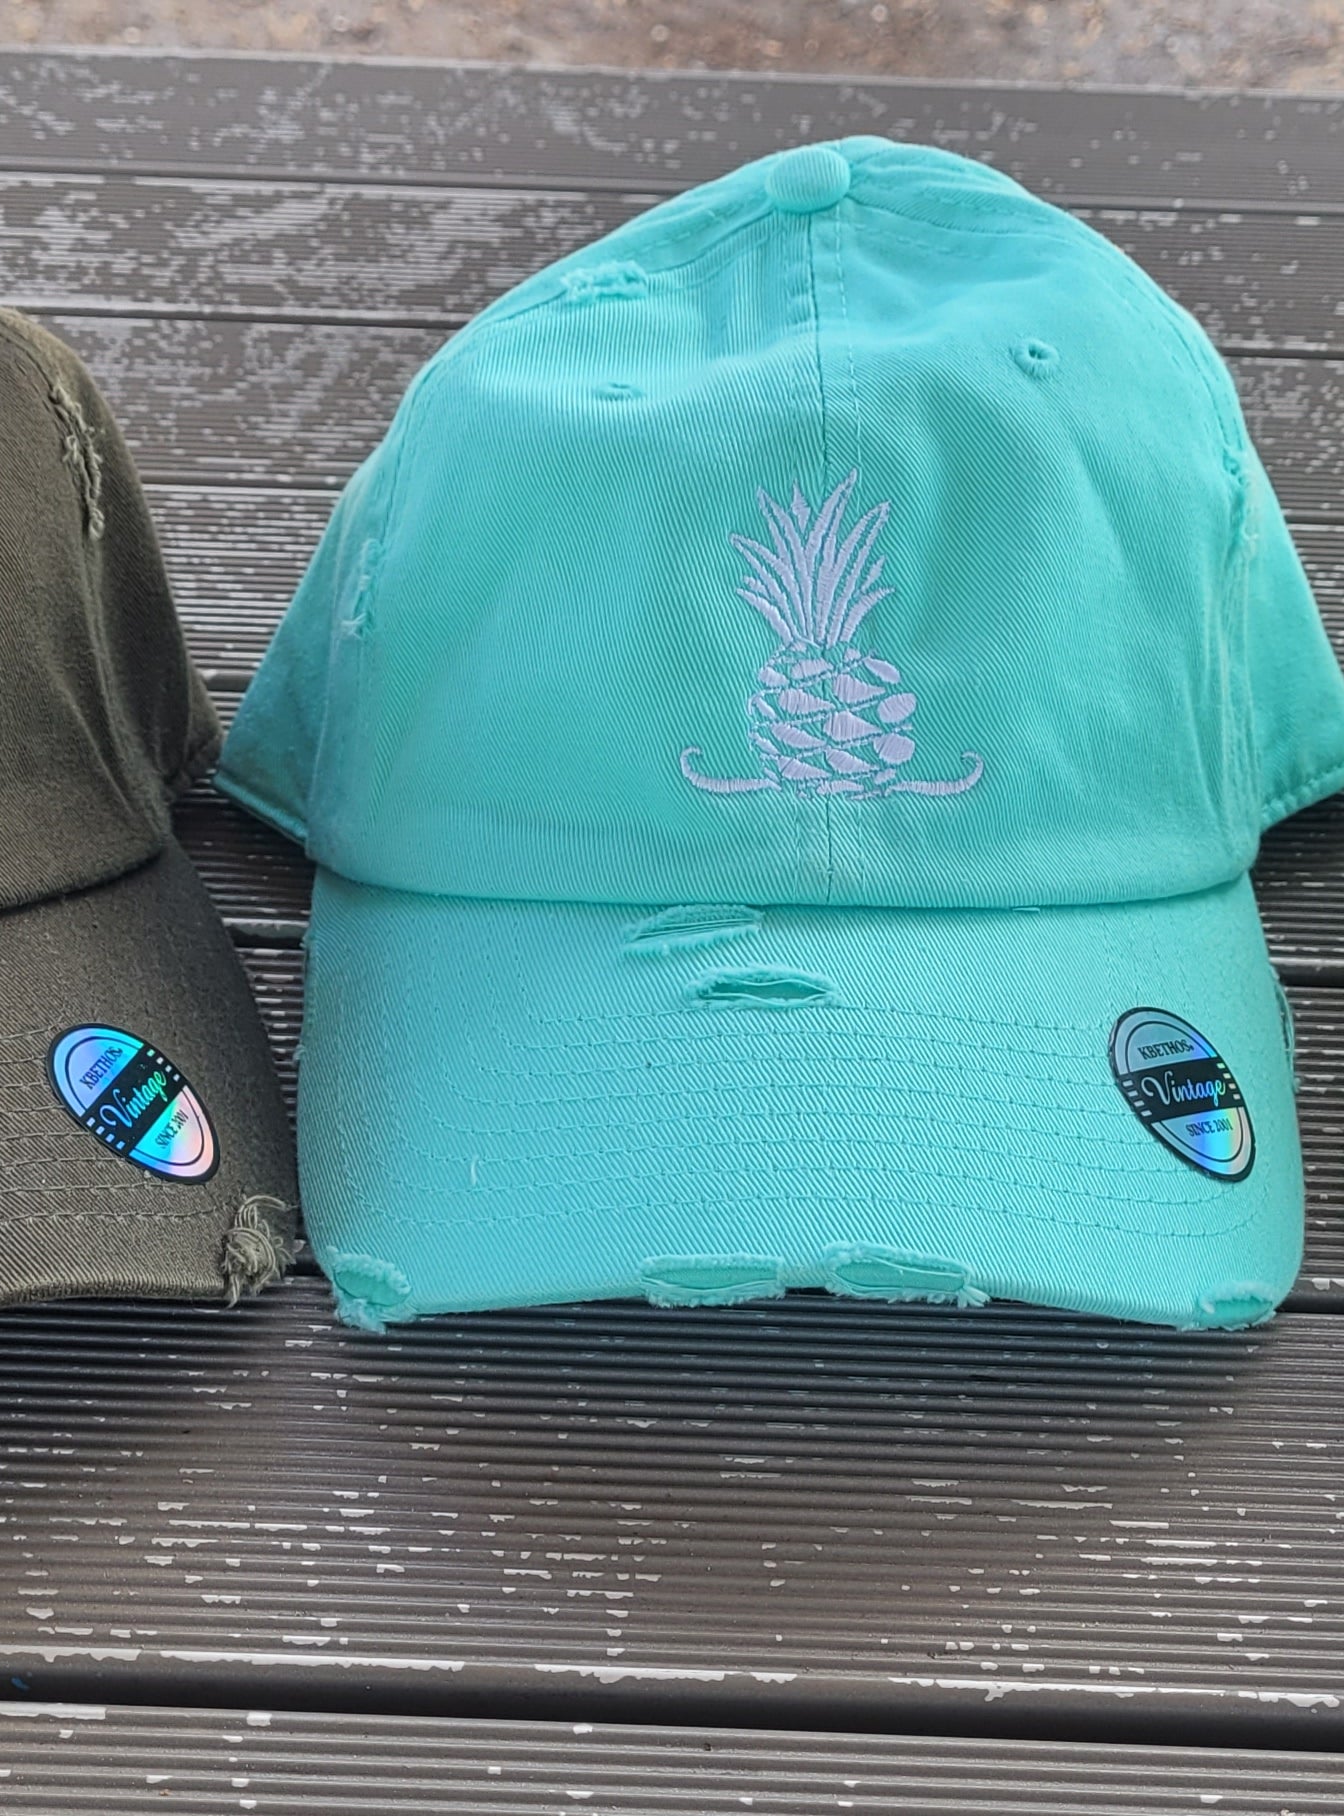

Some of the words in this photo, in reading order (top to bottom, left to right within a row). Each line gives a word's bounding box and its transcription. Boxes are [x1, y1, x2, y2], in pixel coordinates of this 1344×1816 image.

[79, 1046, 122, 1090] KBETHOS
[1137, 1039, 1191, 1060] KBETHOS
[99, 1071, 167, 1128] Vintage
[1141, 1070, 1226, 1107] Vintage
[1185, 1120, 1213, 1137] SINCE
